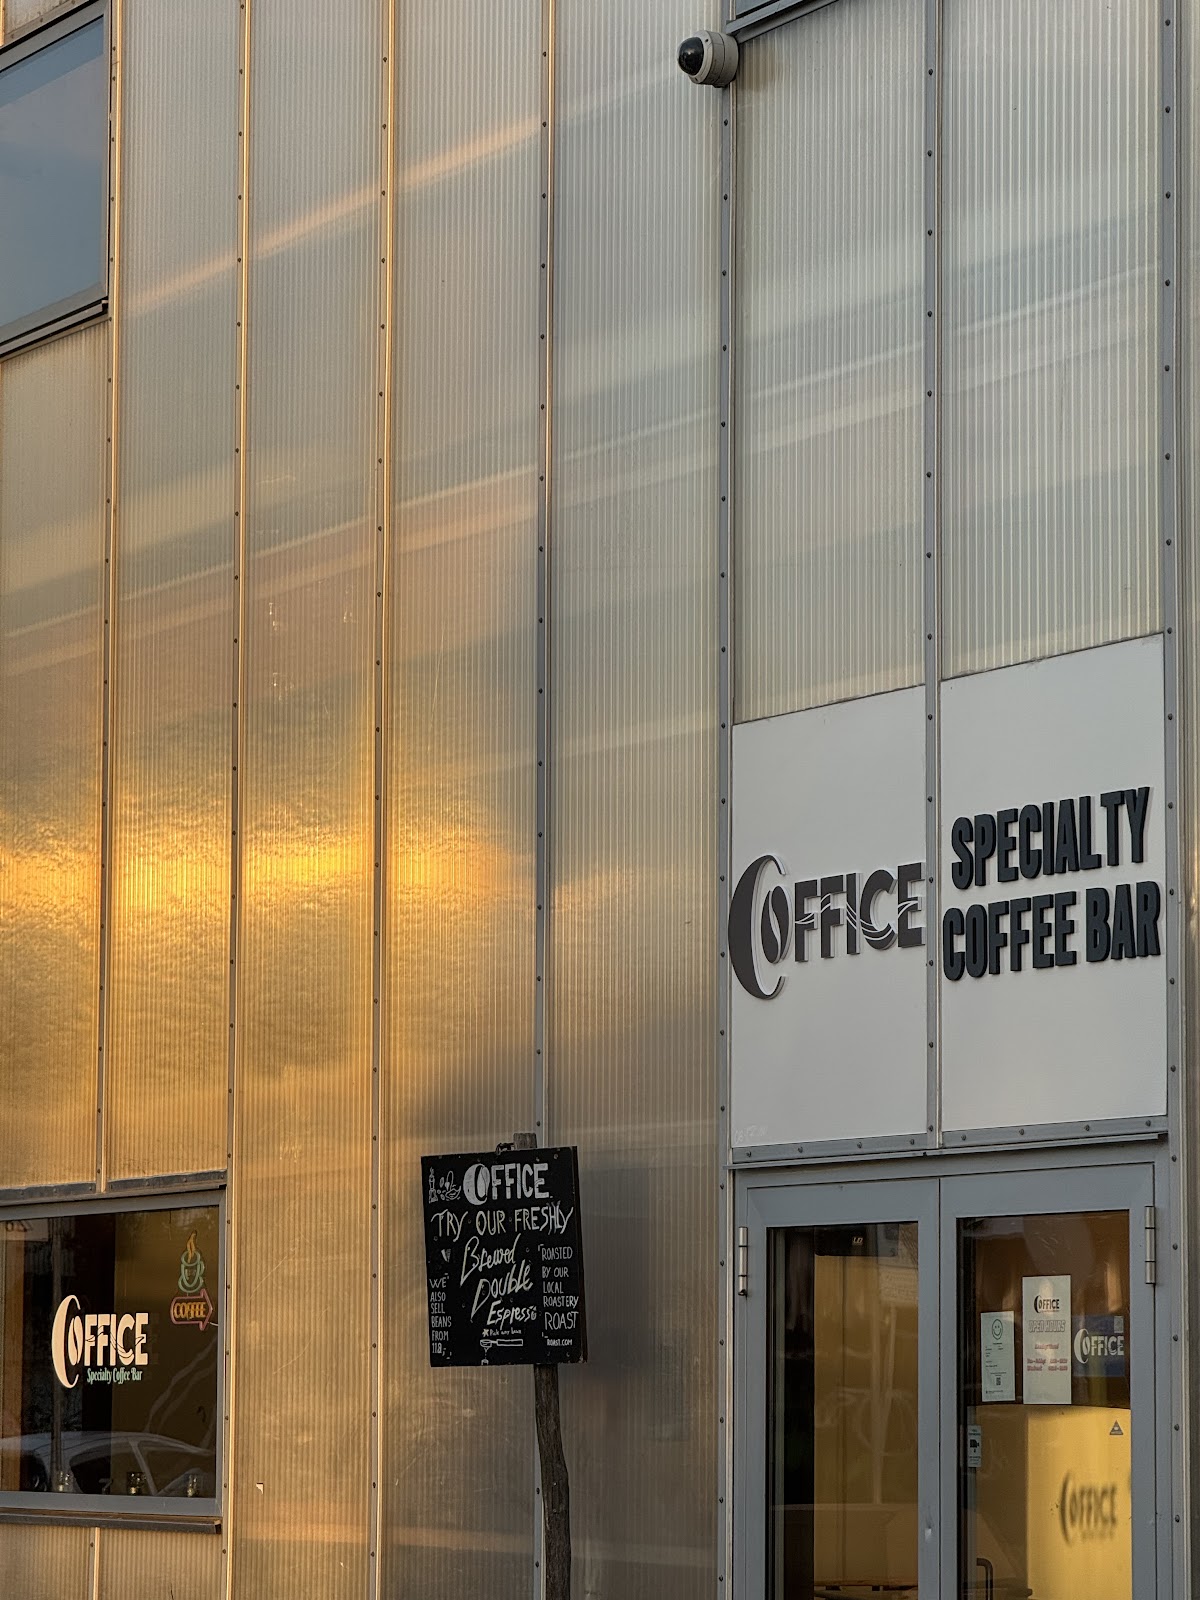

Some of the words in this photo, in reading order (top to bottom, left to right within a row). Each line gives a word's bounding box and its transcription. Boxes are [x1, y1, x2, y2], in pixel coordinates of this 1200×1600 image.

[951, 786, 1151, 890] SPECIALTY
[727, 854, 926, 1000] COFFICE
[943, 891, 1078, 981] COFFEE
[1086, 880, 1161, 963] BAR
[431, 1209, 468, 1242] TRY
[476, 1210, 506, 1236] OUR
[514, 1201, 574, 1236] FRESHLY
[460, 1233, 522, 1287] Brewed
[542, 1246, 573, 1261] ROASTED
[541, 1266, 550, 1279] BY
[553, 1266, 570, 1279] OUR
[429, 1277, 447, 1289] WE
[542, 1281, 564, 1294] LOCAL
[430, 1292, 446, 1302] ALSO
[543, 1295, 579, 1309] ROASTERY
[173, 1302, 206, 1320] COFFEE
[430, 1302, 446, 1315] SELL
[486, 1299, 537, 1331] Espresso
[431, 1315, 452, 1328] BEANS
[544, 1311, 579, 1331] ROAST
[1028, 1319, 1044, 1333] OPEN
[1044, 1319, 1066, 1333] HOURS
[51, 1294, 149, 1389] COFFICE
[431, 1330, 449, 1341] FROM
[87, 1367, 112, 1385] Specialty
[112, 1367, 131, 1385] Coffee
[131, 1367, 143, 1382] Bar
